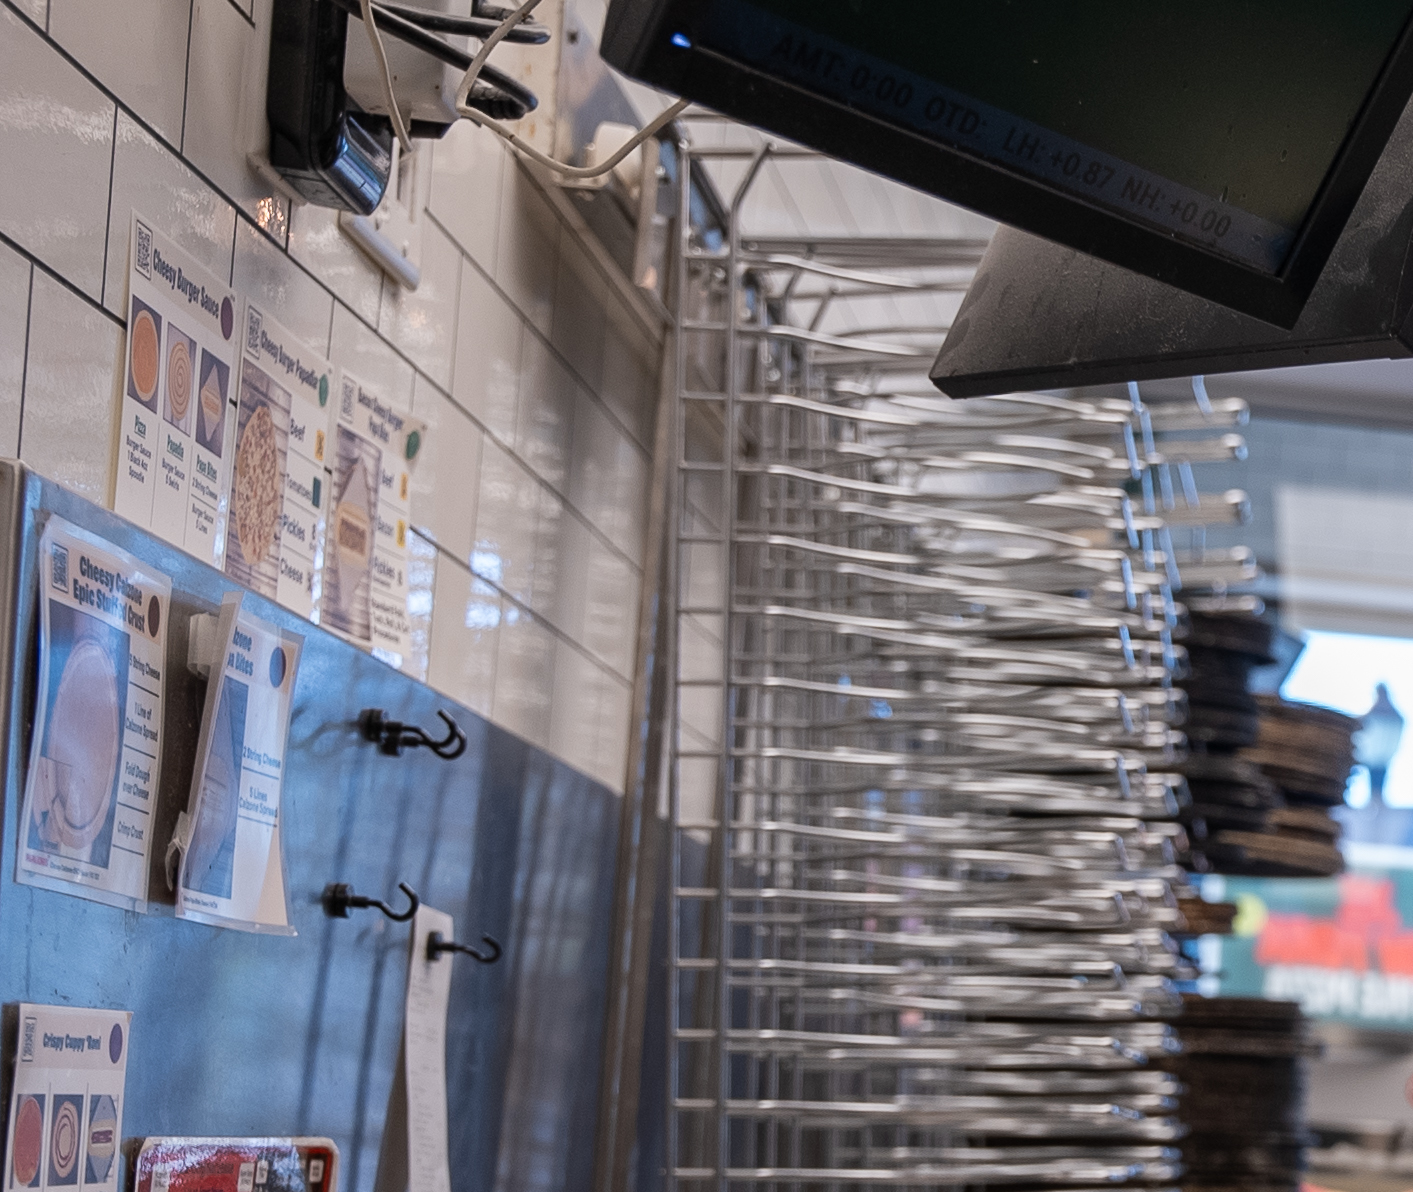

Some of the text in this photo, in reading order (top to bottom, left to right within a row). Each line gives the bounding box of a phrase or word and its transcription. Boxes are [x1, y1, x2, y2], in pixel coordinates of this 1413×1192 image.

[772, 33, 1233, 239] AMT: 0:00 OTD: LH: +0.87 NH: +0.00
[153, 248, 219, 319] Cheesy Burger Sauce
[80, 555, 114, 593] Cheesy
[72, 578, 95, 606] Epic
[128, 604, 145, 634] Crust
[133, 654, 146, 676] String
[146, 662, 160, 682] Cheese
[125, 762, 150, 784] Fold Dough
[118, 820, 144, 840] Crimp Crust
